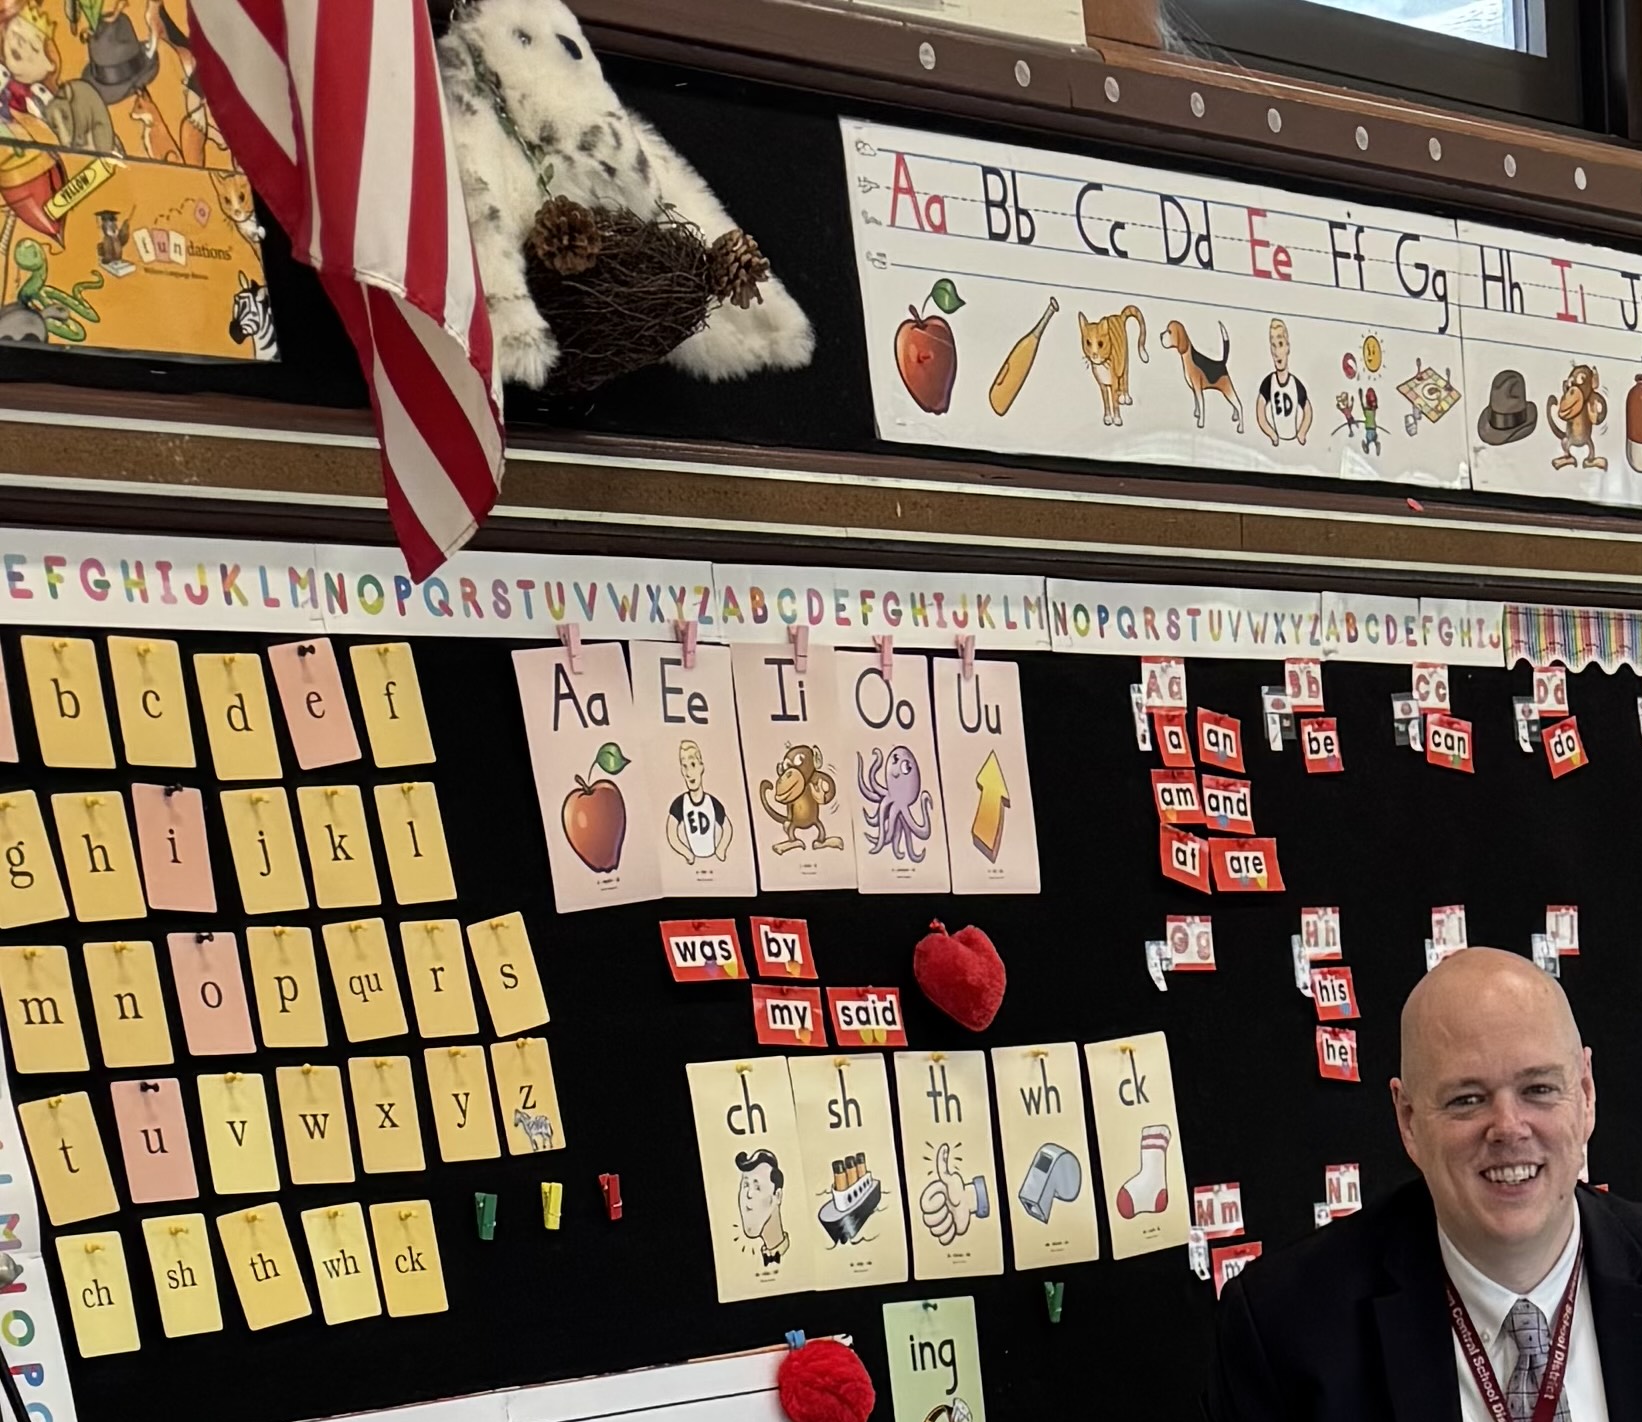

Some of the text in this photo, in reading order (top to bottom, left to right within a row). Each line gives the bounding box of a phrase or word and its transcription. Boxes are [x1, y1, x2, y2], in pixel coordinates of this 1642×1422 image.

[60, 172, 91, 201] YELLOW
[51, 678, 80, 718] b
[142, 690, 162, 718] c
[227, 693, 253, 731] d
[306, 692, 325, 718] e
[384, 681, 399, 719] f
[1169, 728, 1182, 750] a
[1206, 729, 1235, 752] an
[1309, 734, 1334, 755] be
[1431, 729, 1466, 754] can
[1553, 731, 1577, 760] do
[1160, 786, 1195, 807] am
[1207, 790, 1249, 818] and
[687, 811, 710, 835] ED
[6, 841, 34, 889] g
[82, 834, 115, 872] h
[1230, 851, 1264, 874] are
[674, 937, 732, 963] was
[764, 929, 797, 961] by
[350, 973, 383, 1002] qu
[1318, 979, 1346, 1002] his
[769, 1002, 808, 1030] my
[840, 996, 898, 1026] said
[1325, 1038, 1348, 1062] he
[1020, 1058, 1062, 1116] wh
[1118, 1048, 1150, 1106] ck
[726, 1070, 767, 1136] ch
[828, 1068, 863, 1128] sh
[926, 1066, 962, 1123] th
[250, 1253, 280, 1282] th
[323, 1249, 360, 1278] wh
[396, 1246, 427, 1273] ck
[167, 1260, 197, 1289] sh
[83, 1279, 114, 1308] ch
[909, 1336, 957, 1394] ing
[1453, 1308, 1479, 1355] Central
[1473, 1355, 1500, 1402] School
